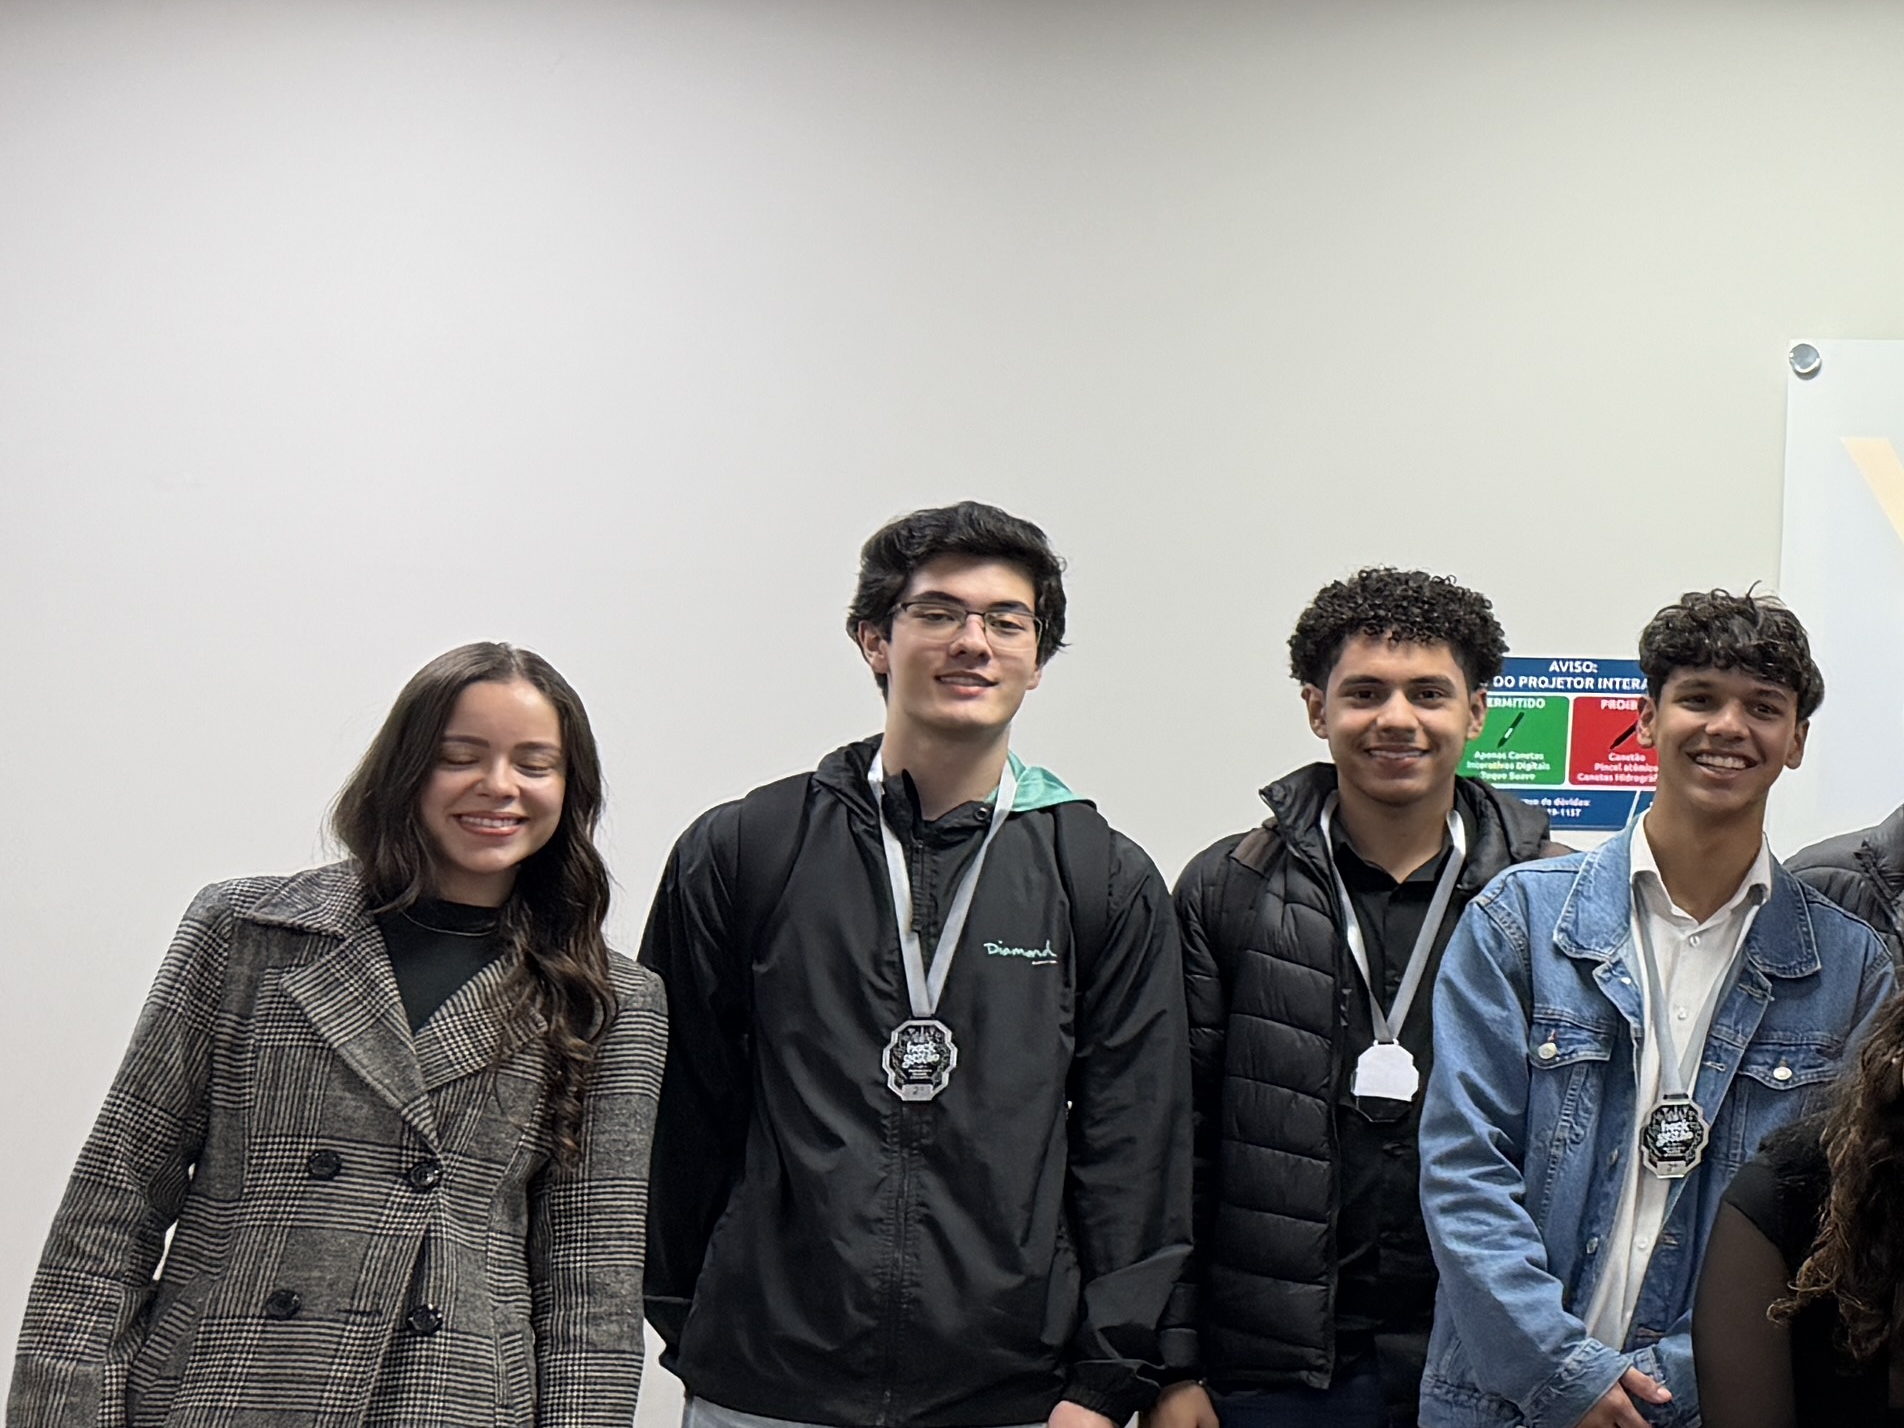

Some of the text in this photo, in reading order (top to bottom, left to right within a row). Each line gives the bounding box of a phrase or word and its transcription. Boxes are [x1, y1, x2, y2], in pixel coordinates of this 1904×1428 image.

[1549, 660, 1598, 673] AVISO:
[1493, 676, 1515, 688] DO
[1518, 676, 1594, 690] PROJETOR
[1486, 697, 1546, 709] ERMITIDO
[983, 939, 1058, 958] Diamond
